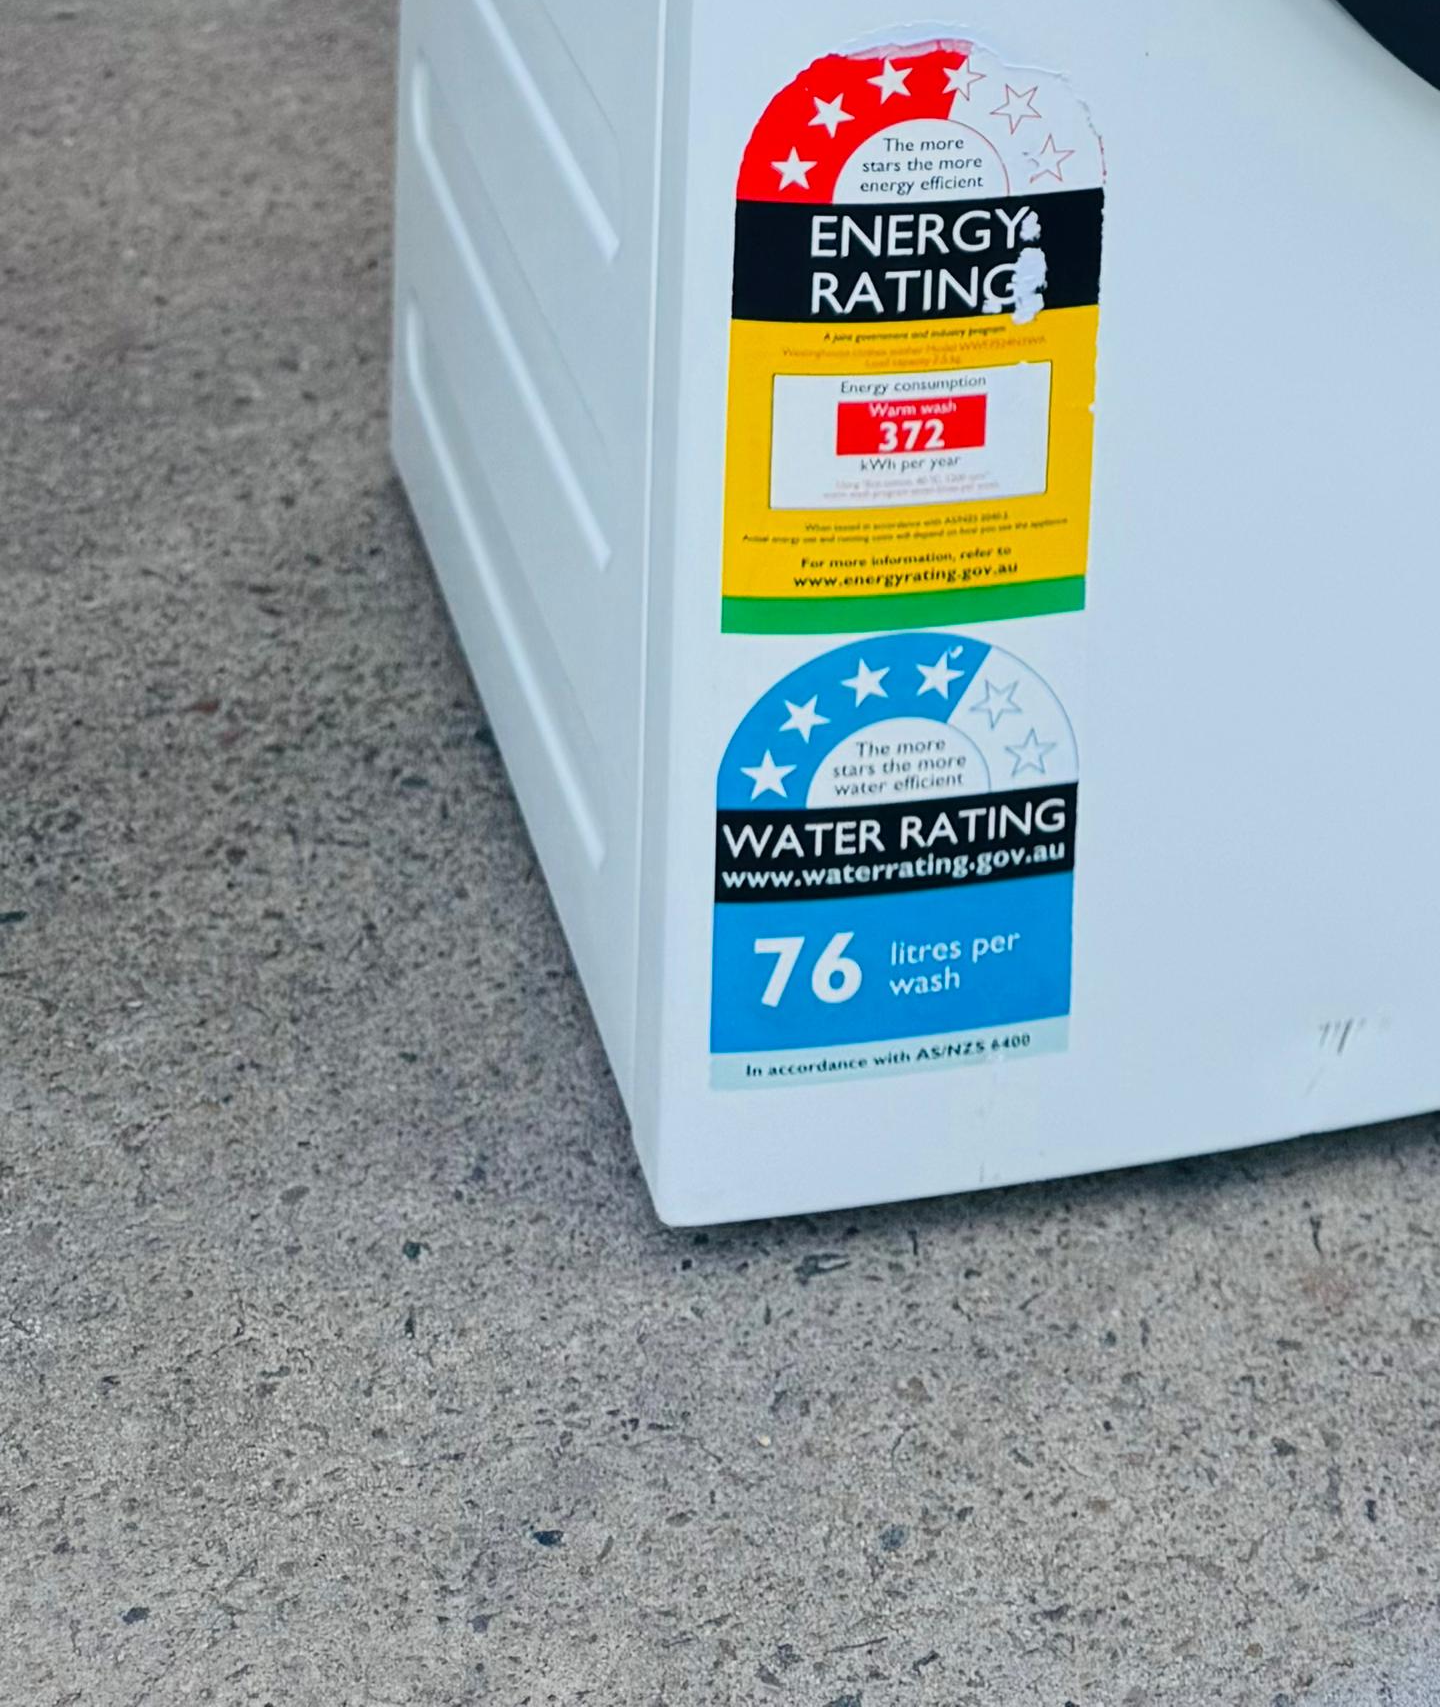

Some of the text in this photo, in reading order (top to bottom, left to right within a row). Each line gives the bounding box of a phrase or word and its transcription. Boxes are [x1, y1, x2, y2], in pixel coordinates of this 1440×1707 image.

[883, 137, 965, 152] The more
[862, 157, 983, 173] stars the more
[860, 175, 984, 196] energy efficient
[810, 205, 1030, 259] ENERGY
[810, 262, 1024, 316] RATING
[840, 374, 987, 396] Energy consumption
[868, 399, 958, 418] Warm wash
[877, 417, 946, 455] 372
[860, 456, 963, 472] kWh per year
[801, 557, 824, 569] For
[829, 558, 867, 569] more
[959, 547, 993, 560] refer
[997, 546, 1012, 557] to
[793, 562, 1019, 588] www.energyrating.gov.au
[855, 738, 946, 758] The more
[833, 754, 967, 778] stars the more
[834, 772, 965, 796] water efficient
[721, 797, 1067, 860] WATER RATING
[720, 840, 1066, 889] www.waterrating.gov.au
[890, 930, 1021, 967] litres per
[752, 930, 864, 1009] 76
[888, 964, 961, 997] wash
[745, 1063, 763, 1078] In
[767, 1057, 868, 1077] accordance
[872, 1049, 911, 1067] with
[915, 1040, 986, 1062] AS/NZS
